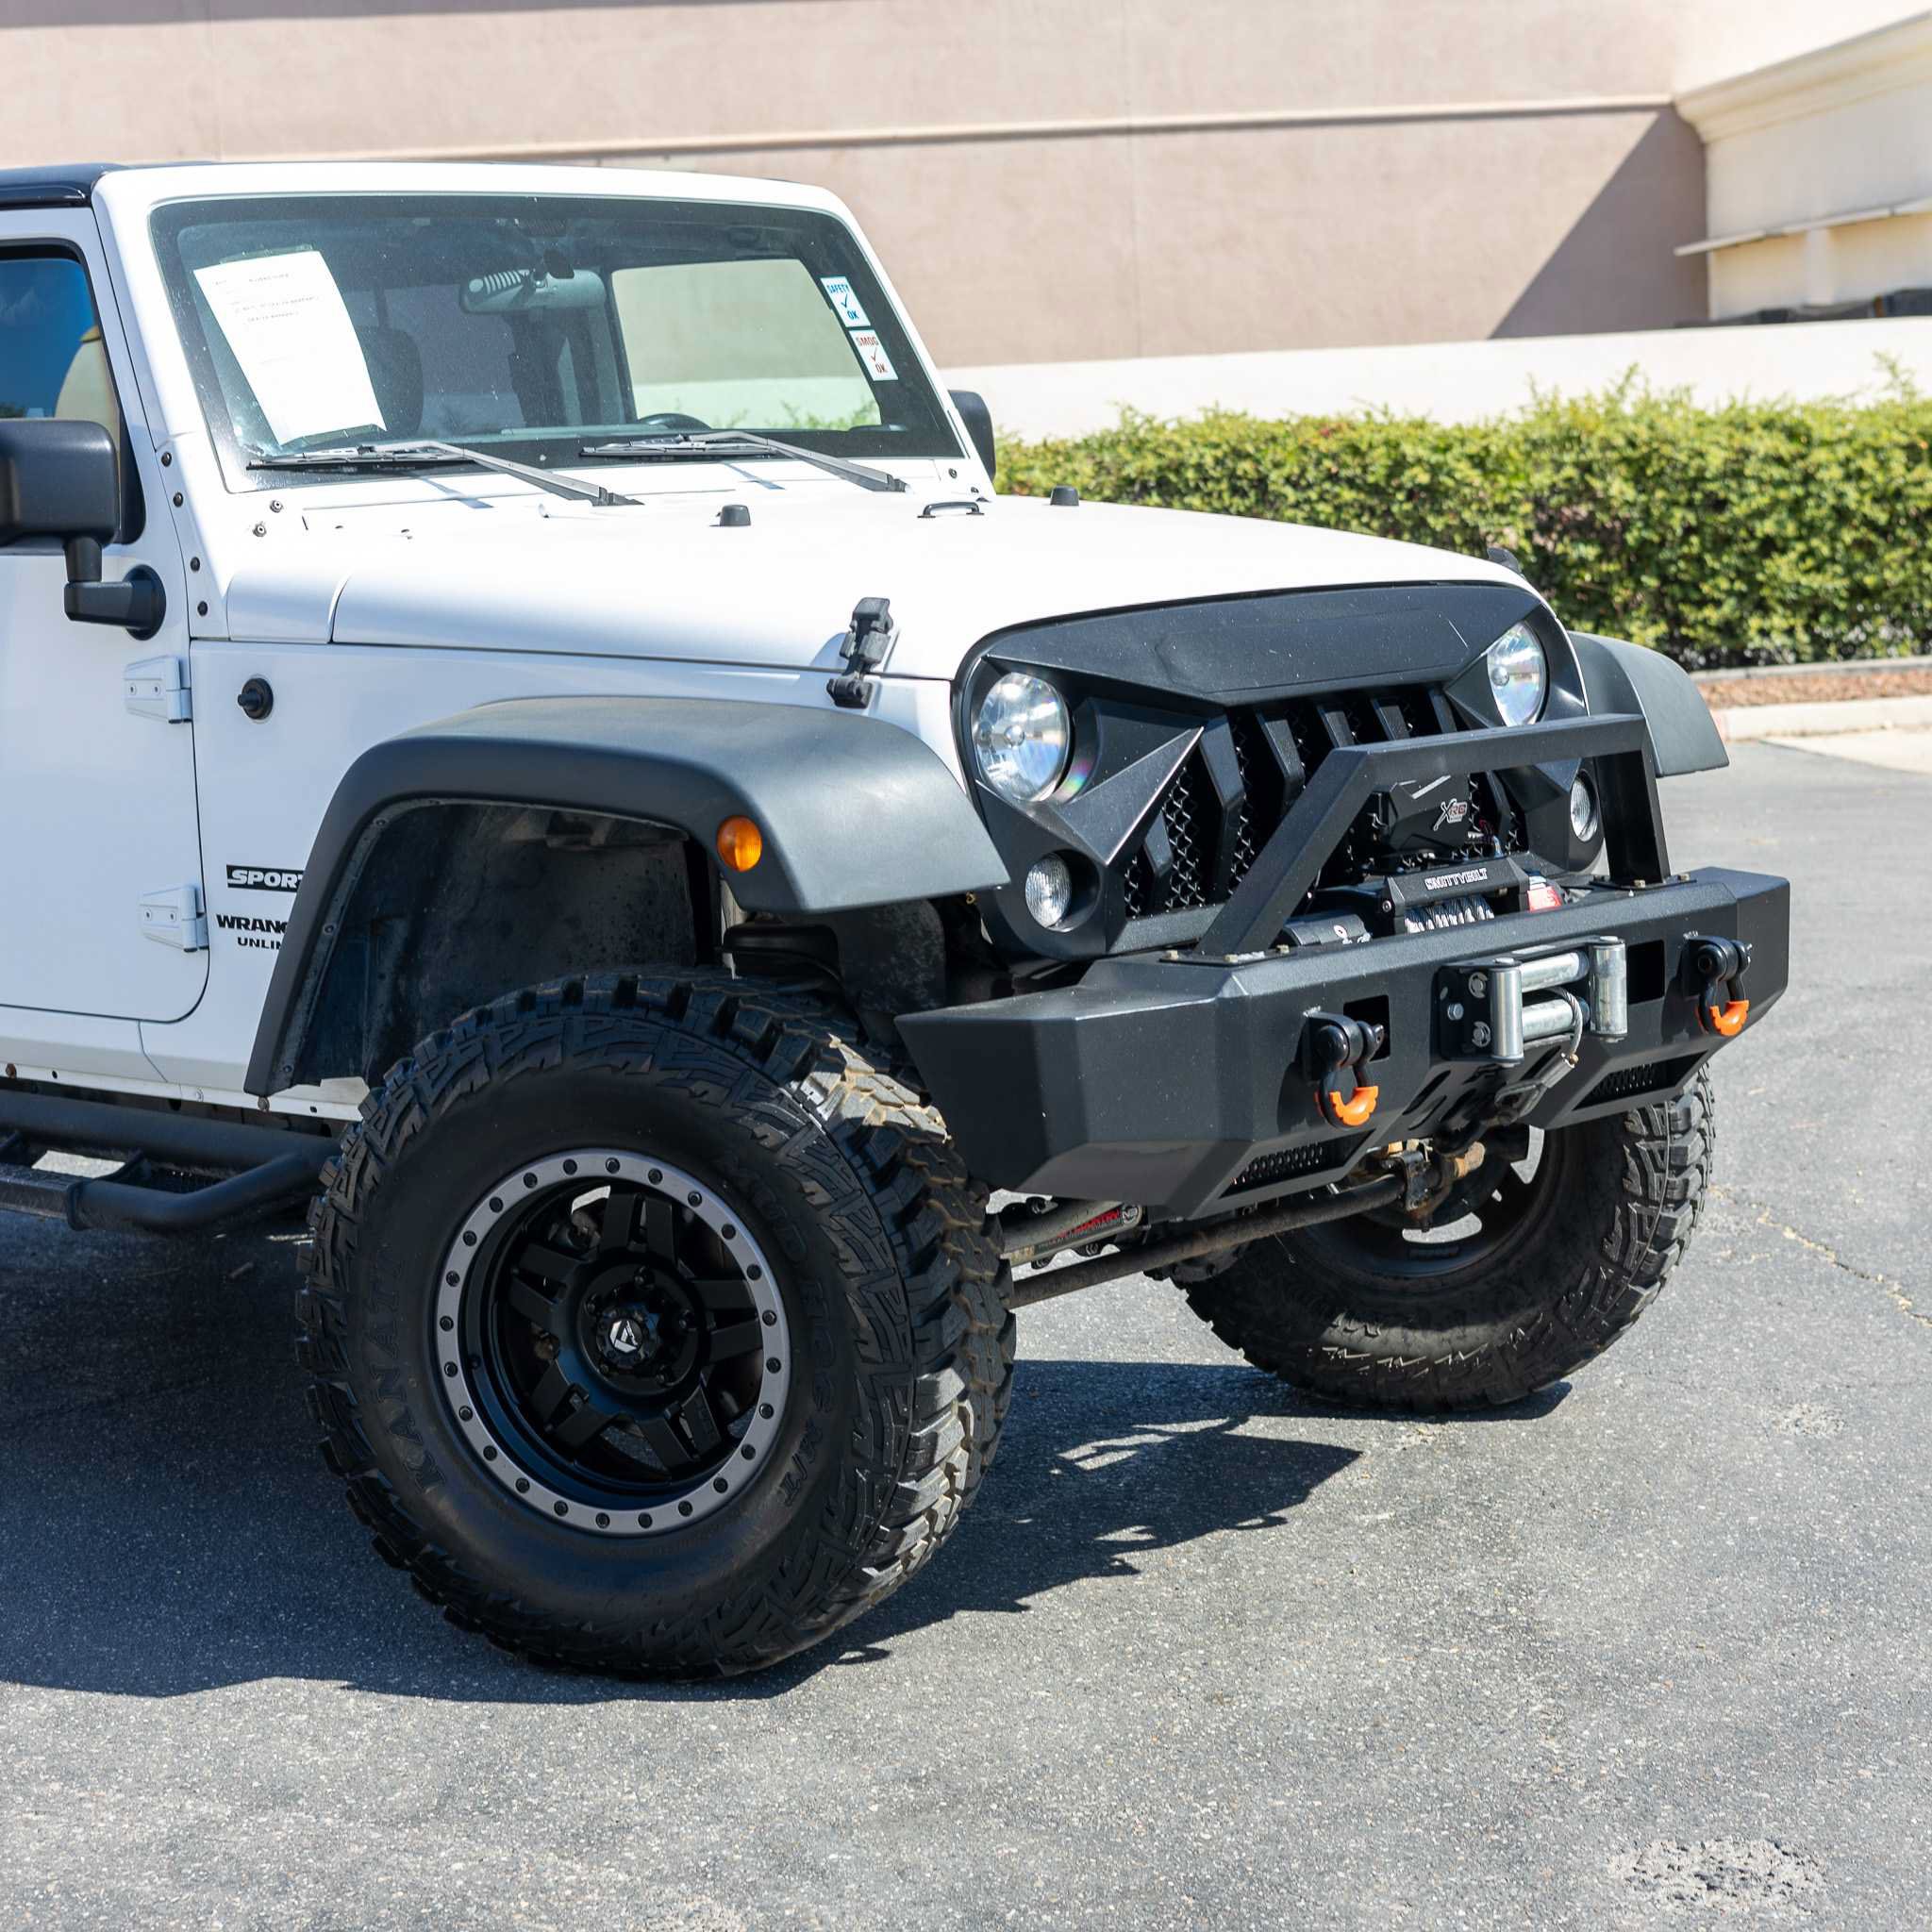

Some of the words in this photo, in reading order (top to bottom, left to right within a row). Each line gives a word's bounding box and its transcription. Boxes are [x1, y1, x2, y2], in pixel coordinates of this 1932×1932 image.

[826, 284, 850, 293] SAFETY
[847, 310, 858, 320] OK
[876, 363, 888, 374] OK
[1424, 867, 1489, 891] SMITTYBILT
